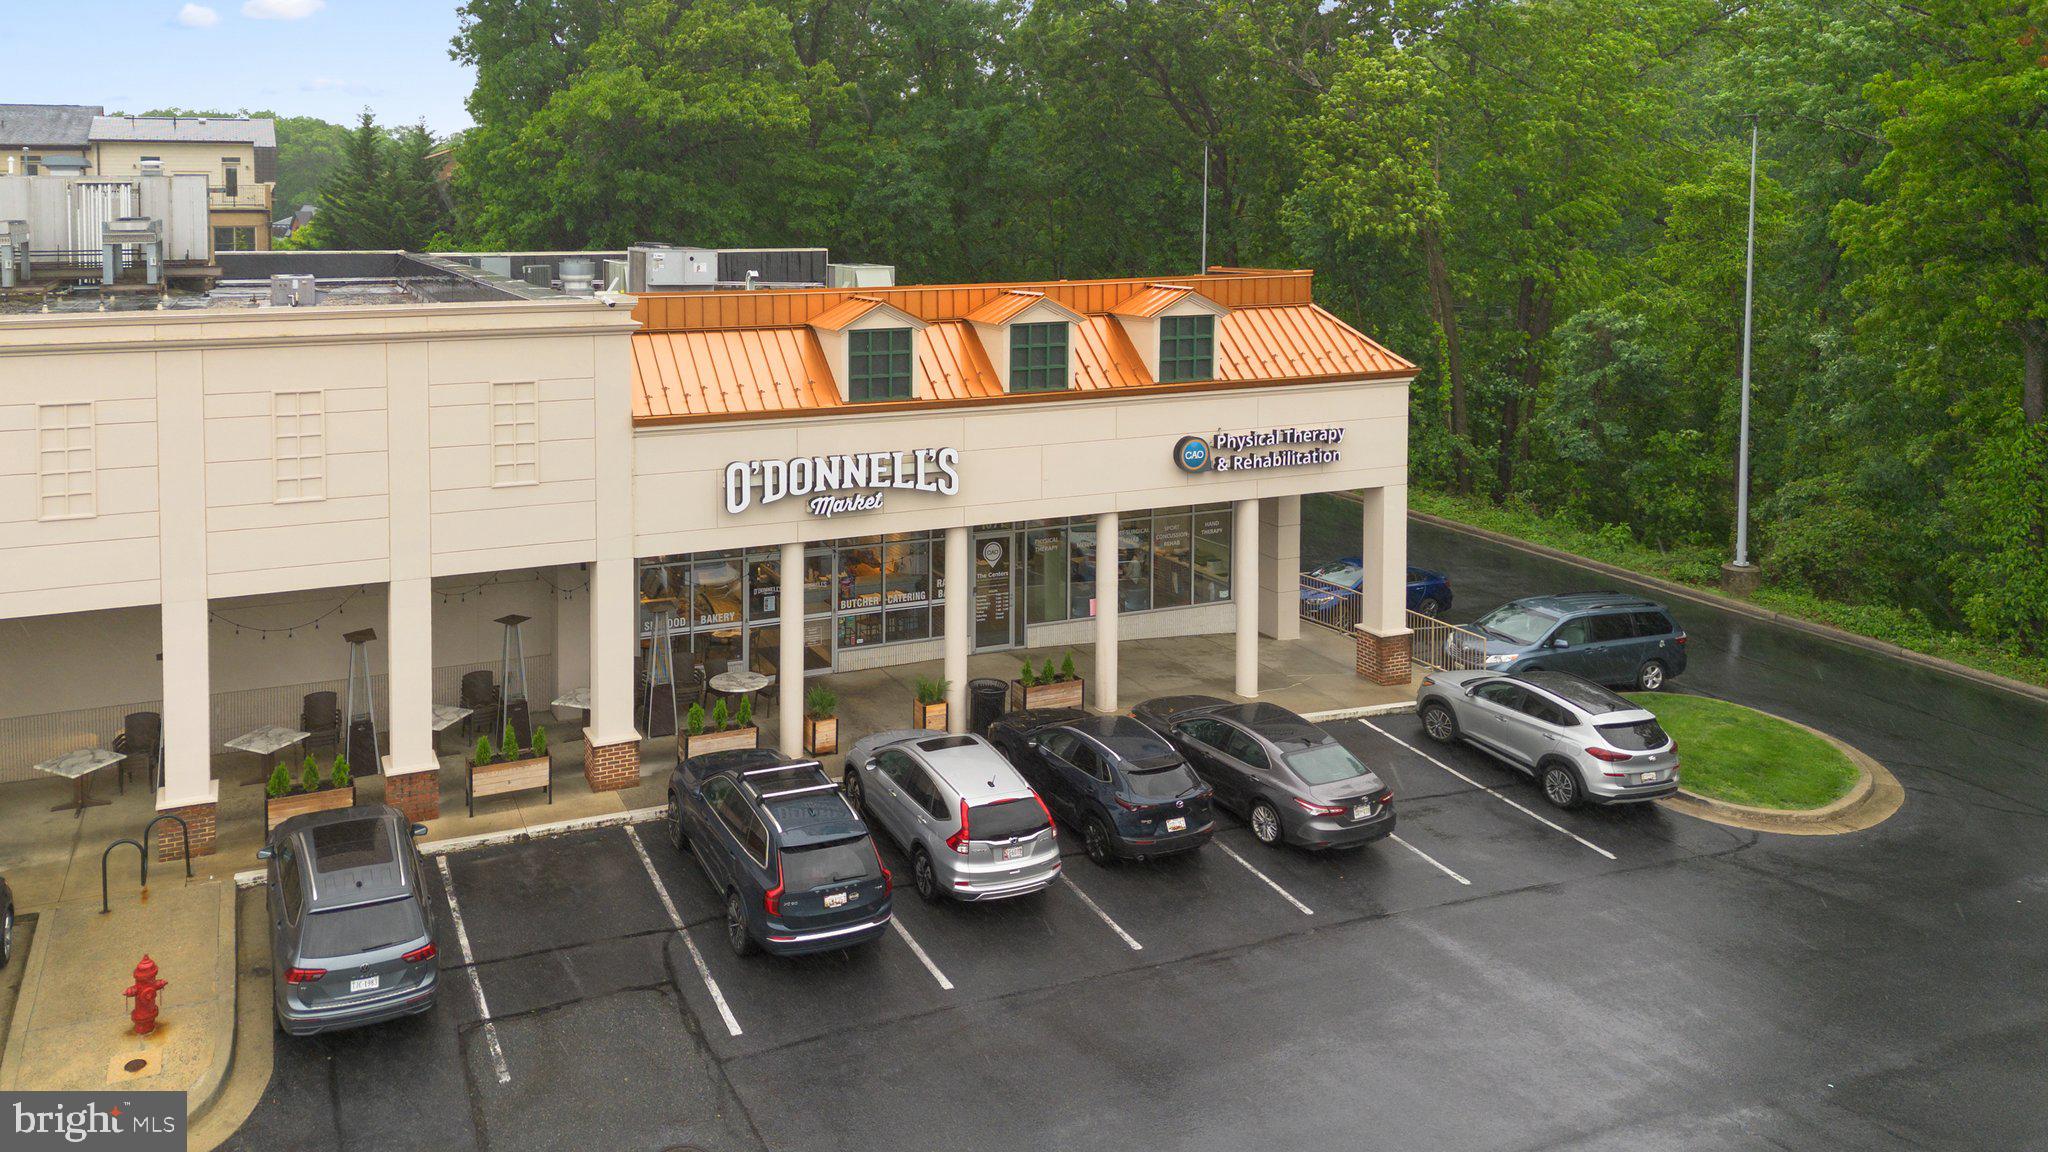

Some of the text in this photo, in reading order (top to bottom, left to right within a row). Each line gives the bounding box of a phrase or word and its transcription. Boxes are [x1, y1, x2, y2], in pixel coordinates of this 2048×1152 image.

[1216, 427, 1346, 452] Physical Therapy
[1184, 450, 1204, 460] CAO
[1217, 449, 1341, 472] & Rehabilitation
[725, 446, 960, 514] O'DONNELL'S
[810, 492, 883, 518] Market
[840, 596, 879, 609] BUTCHER
[887, 591, 926, 604] CATERING
[700, 612, 735, 625] BAKERY
